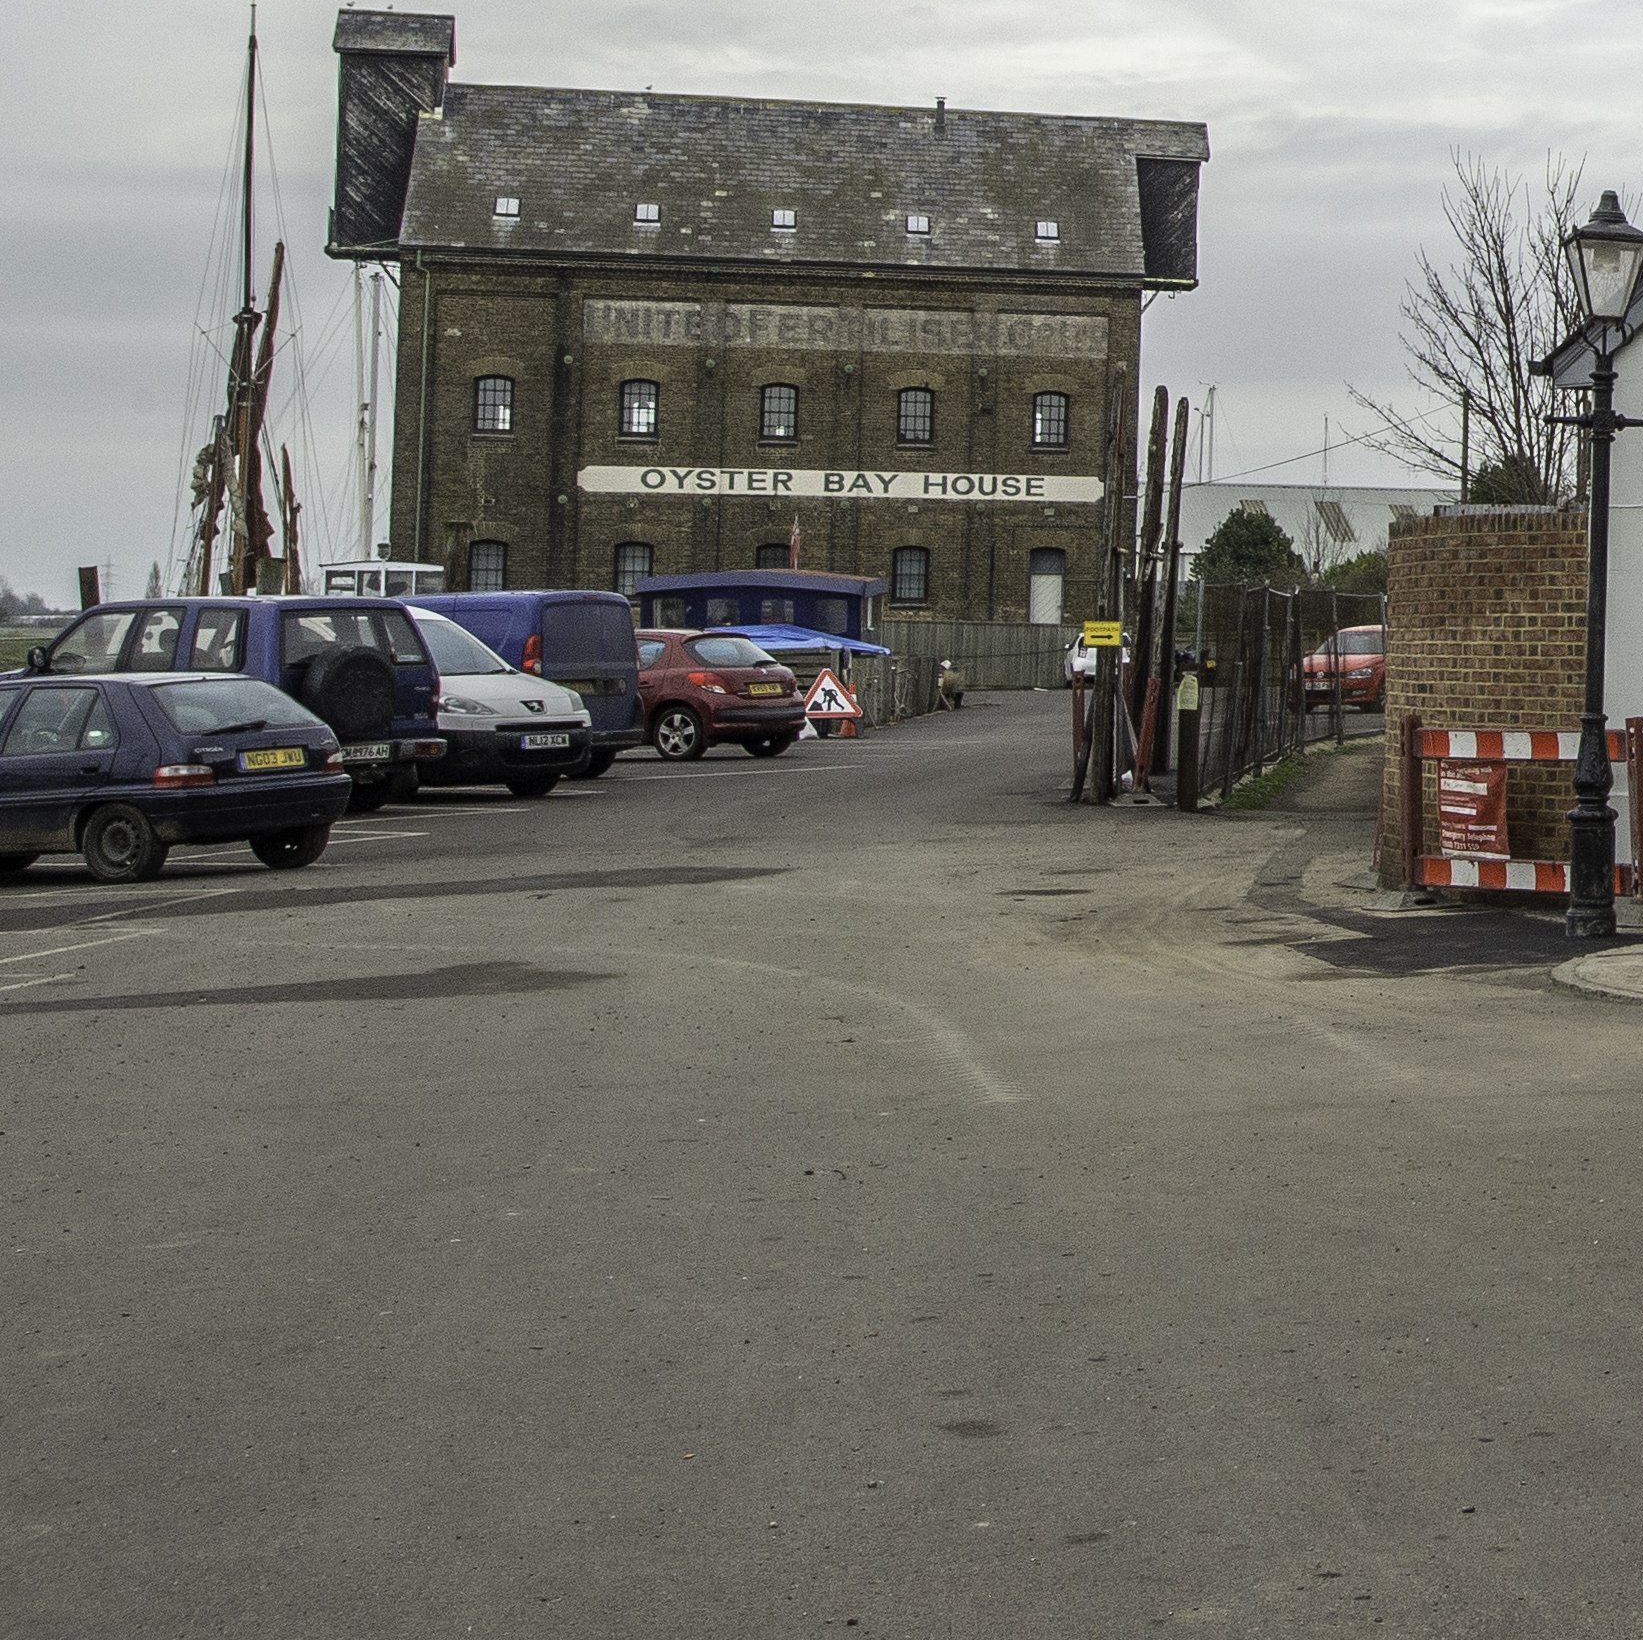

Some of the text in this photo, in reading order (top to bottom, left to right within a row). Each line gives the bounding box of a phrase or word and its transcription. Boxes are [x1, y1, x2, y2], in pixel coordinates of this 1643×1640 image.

[640, 467, 1046, 498] OYSTER BAY HOUSE
